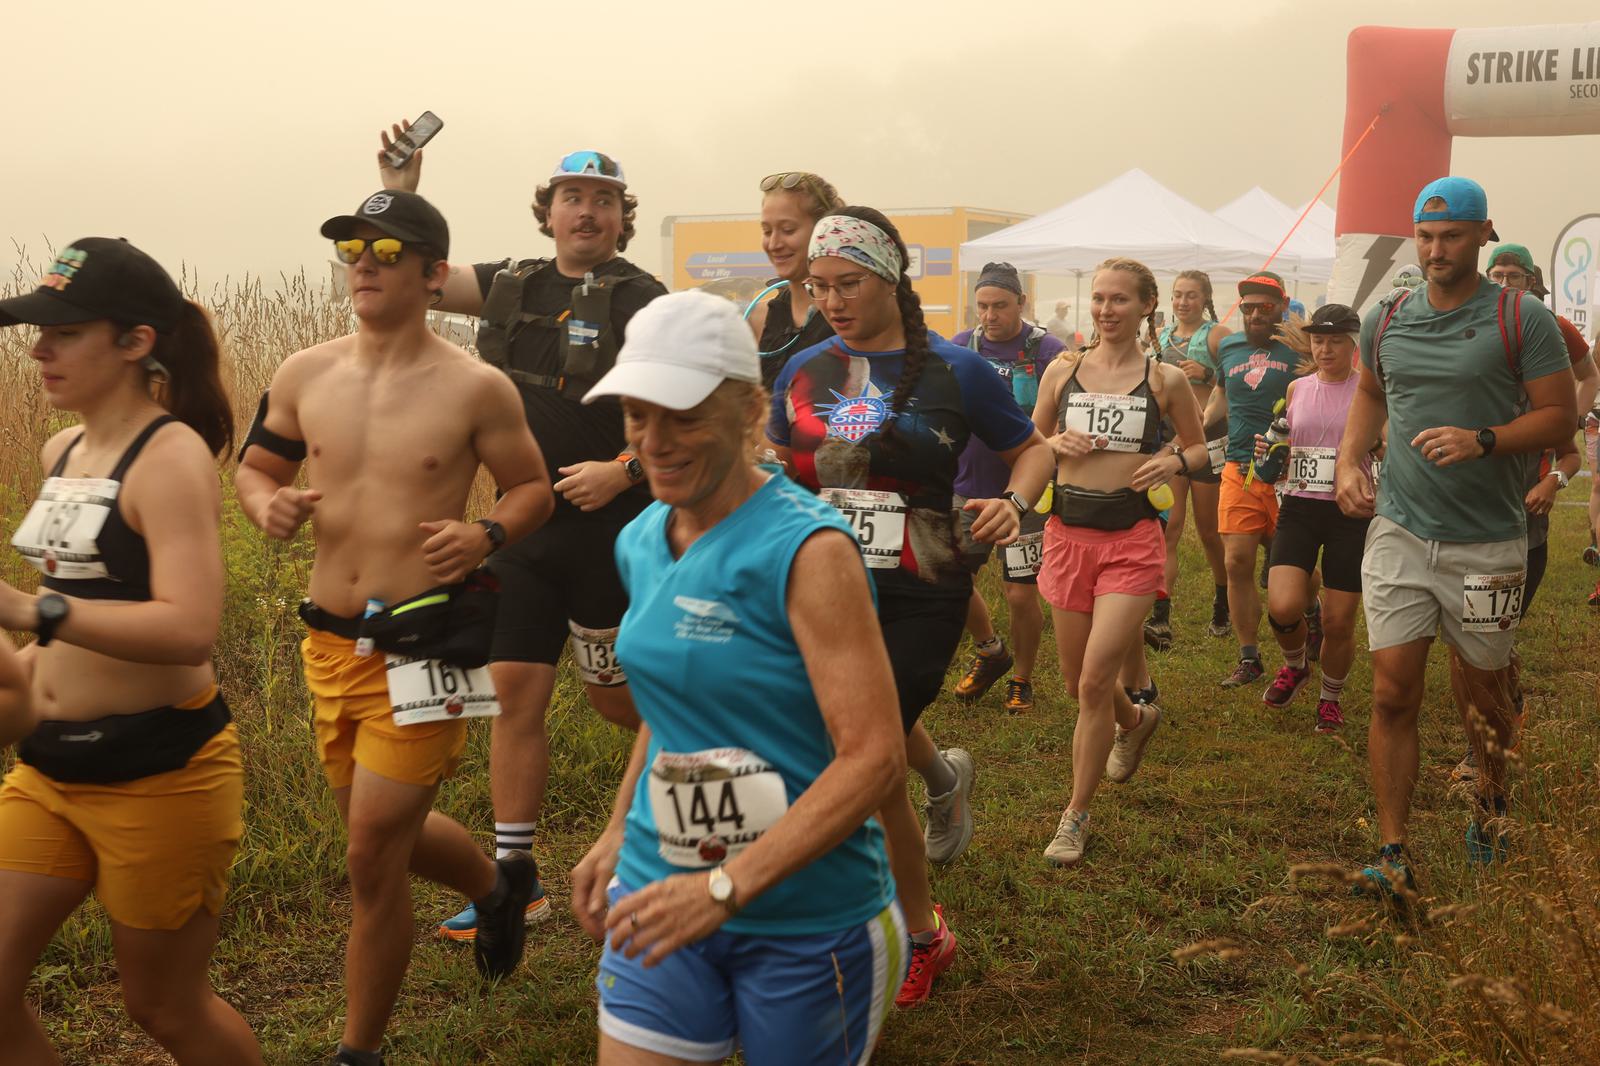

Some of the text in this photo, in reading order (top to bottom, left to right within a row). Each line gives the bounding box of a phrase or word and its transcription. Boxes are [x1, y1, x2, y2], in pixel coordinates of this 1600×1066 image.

[1466, 47, 1600, 85] STRIKE LI
[1569, 84, 1600, 99] SECO
[831, 414, 880, 423] ONE
[1086, 408, 1124, 434] 152
[1294, 458, 1318, 478] 163
[1488, 587, 1522, 616] 173
[666, 781, 745, 834] 144
